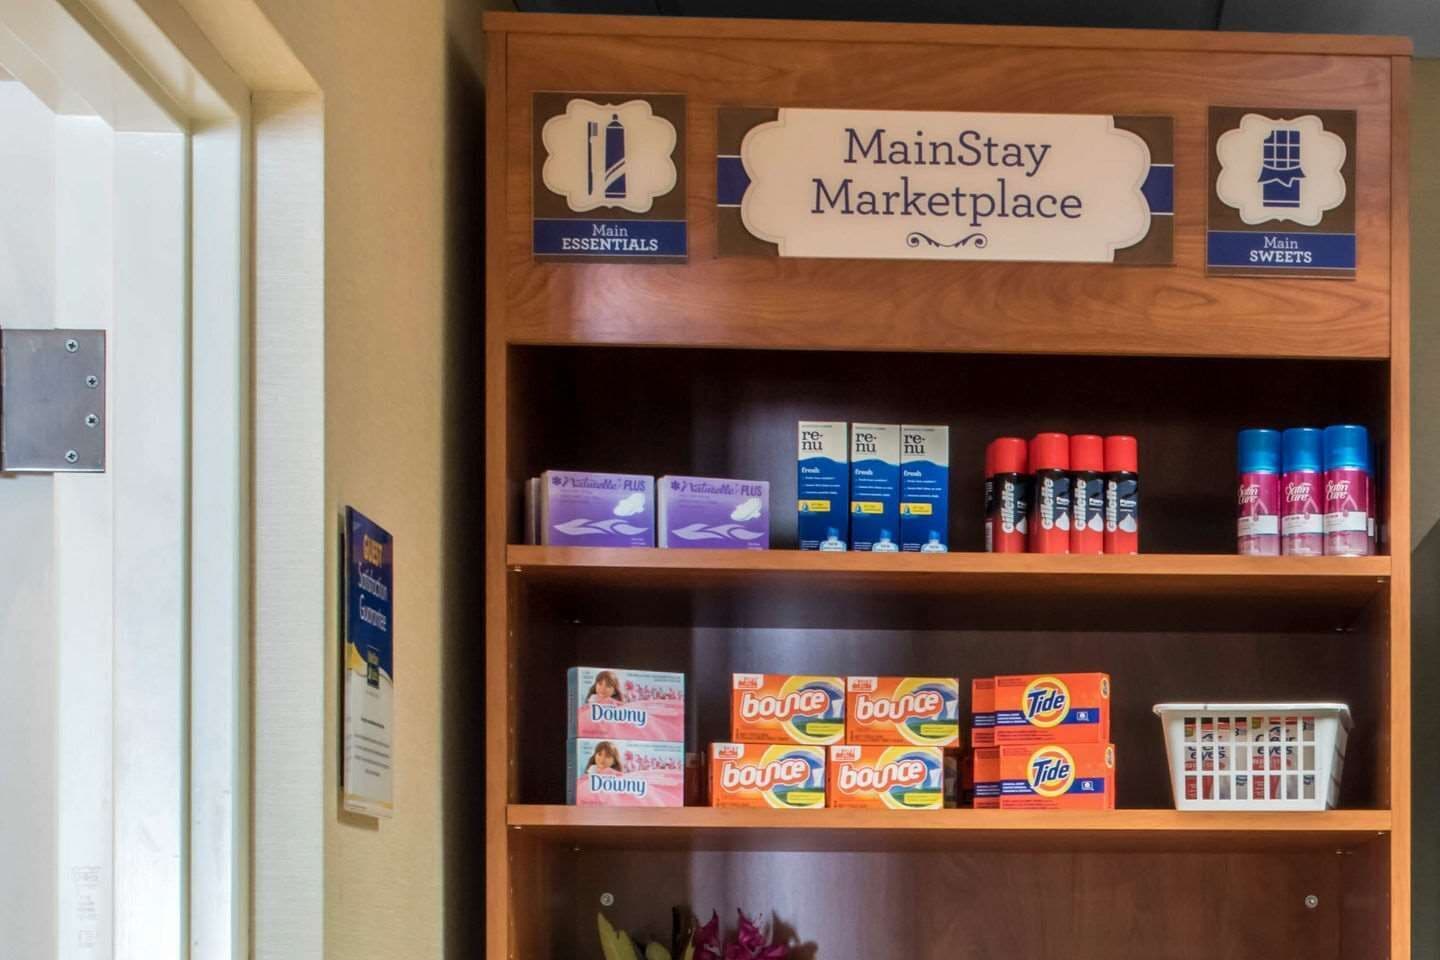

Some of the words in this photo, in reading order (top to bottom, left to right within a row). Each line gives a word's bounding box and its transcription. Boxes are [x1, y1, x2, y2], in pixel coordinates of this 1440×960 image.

[843, 128, 1051, 177] MainStay
[810, 176, 1083, 227] Marketplace
[591, 224, 629, 237] Main
[1263, 236, 1299, 249] Main
[561, 238, 659, 251] ESSENTIALS
[1249, 250, 1313, 263] SWEETS
[623, 479, 646, 491] PLUS
[740, 484, 763, 496] PLUS
[1001, 480, 1015, 533] Gillette
[1040, 476, 1054, 530] Gillette
[1074, 478, 1087, 531] Gillette
[1106, 480, 1118, 532] Gillette
[591, 703, 646, 726] Downy
[742, 691, 825, 718] bounce
[857, 692, 939, 719] bounce
[1027, 688, 1065, 718] Tide
[591, 775, 646, 795] Downy
[722, 760, 806, 788] bounce
[839, 760, 925, 789] bounce
[1032, 759, 1071, 787] Tide
